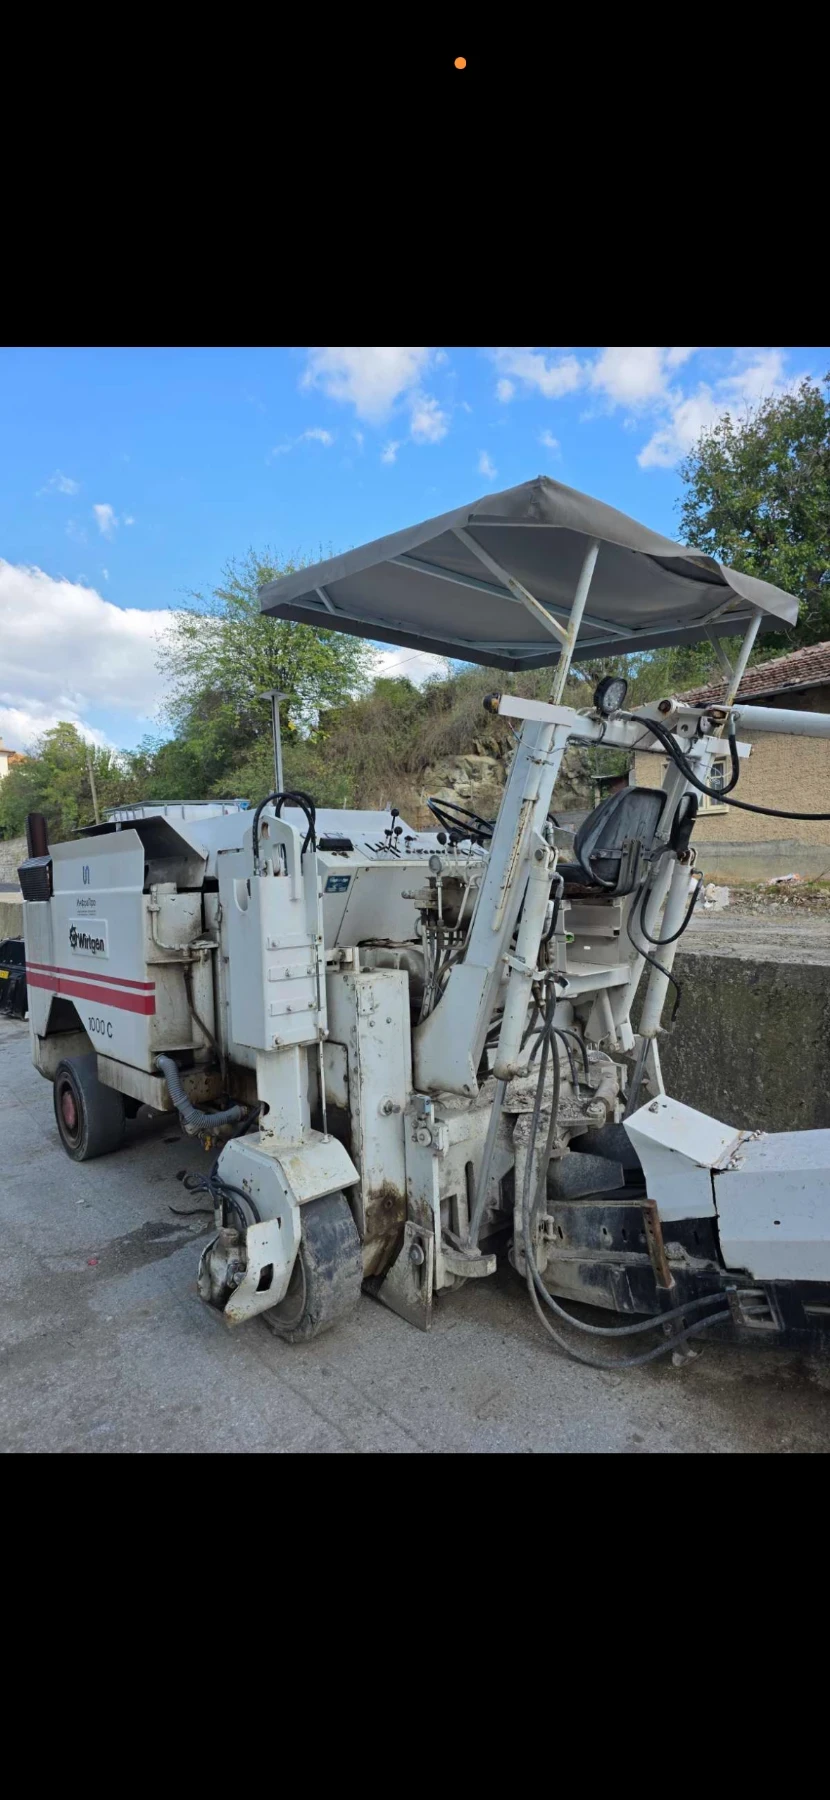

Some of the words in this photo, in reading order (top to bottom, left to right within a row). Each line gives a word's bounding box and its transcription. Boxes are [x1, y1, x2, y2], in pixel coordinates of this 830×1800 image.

[78, 932, 105, 954] Wirtgen
[88, 1017, 105, 1035] 1000
[106, 1021, 113, 1038] C
